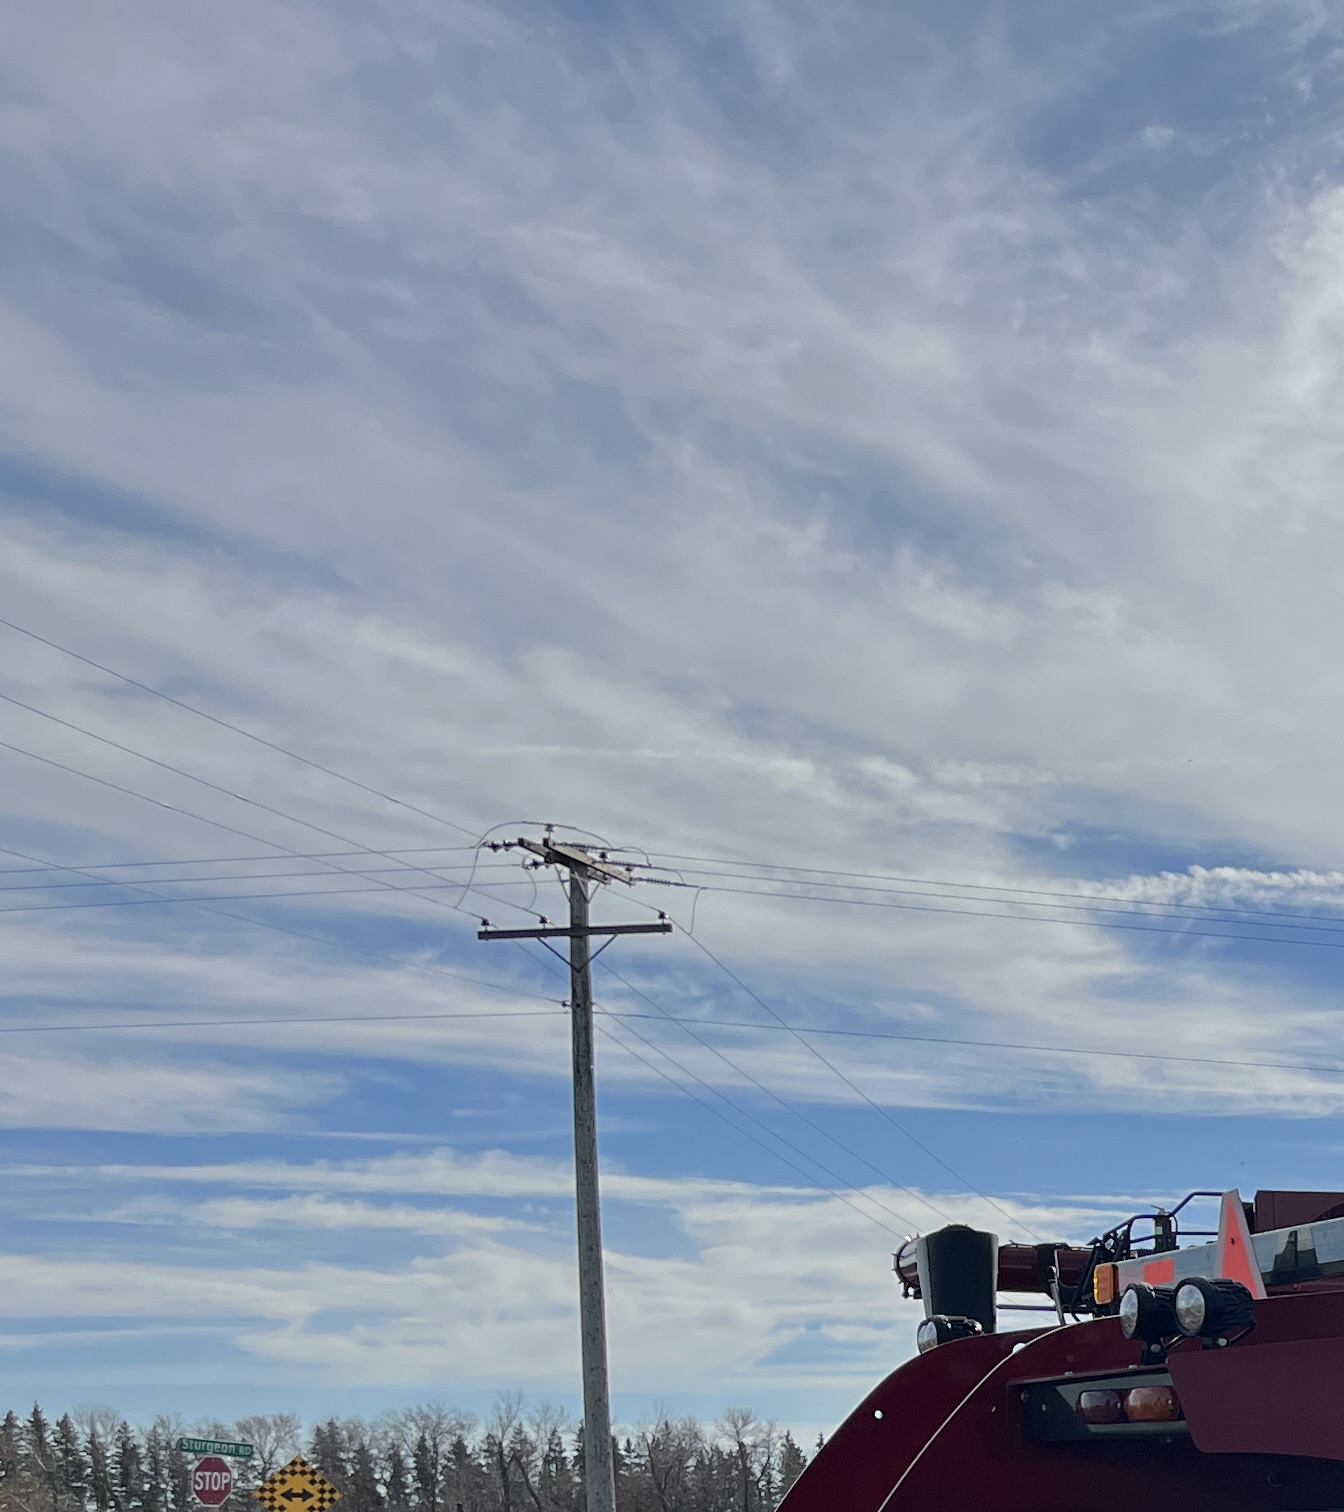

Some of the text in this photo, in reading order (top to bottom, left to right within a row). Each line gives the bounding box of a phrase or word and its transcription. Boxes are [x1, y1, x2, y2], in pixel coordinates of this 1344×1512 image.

[182, 1438, 252, 1456] Sturgeon RD
[194, 1471, 231, 1491] STOP
